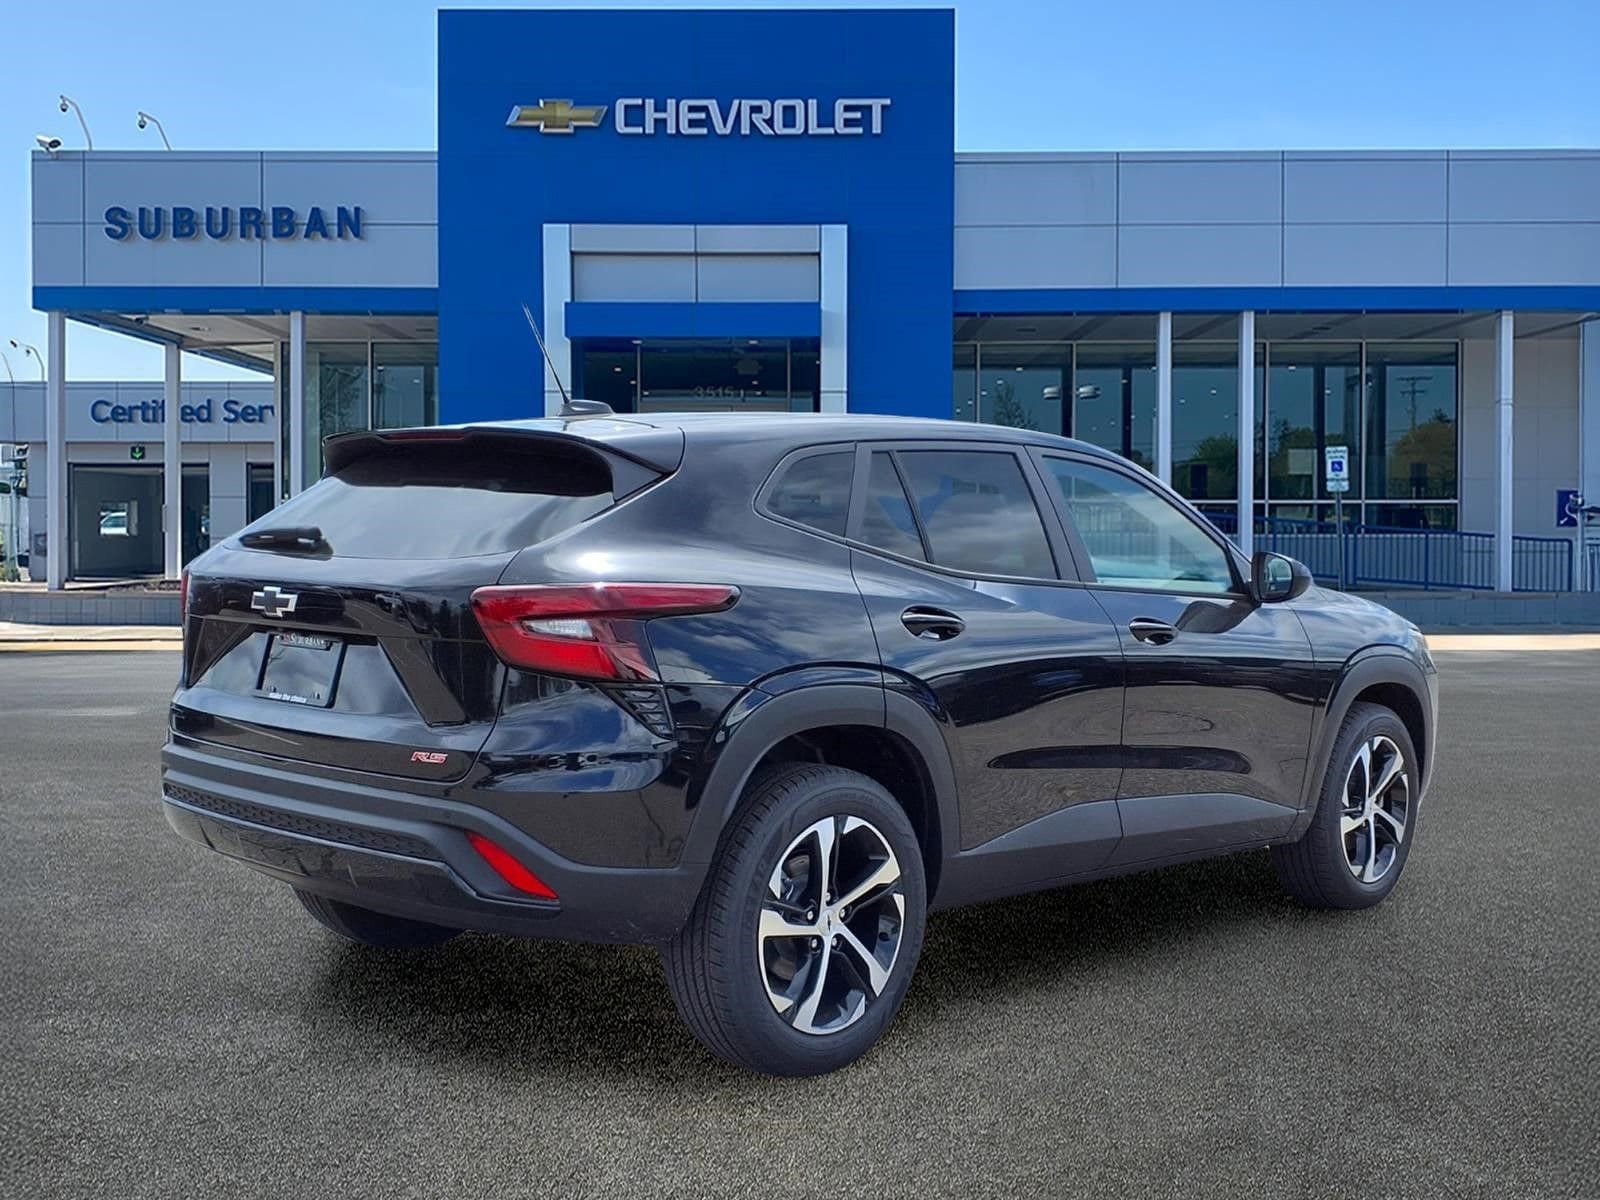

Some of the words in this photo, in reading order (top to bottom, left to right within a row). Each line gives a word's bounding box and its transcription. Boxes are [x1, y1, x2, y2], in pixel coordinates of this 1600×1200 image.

[615, 98, 891, 135] CHEVROLET
[104, 206, 361, 240] SUBURBAN
[91, 399, 212, 423] Certifed
[410, 751, 449, 764] RS
